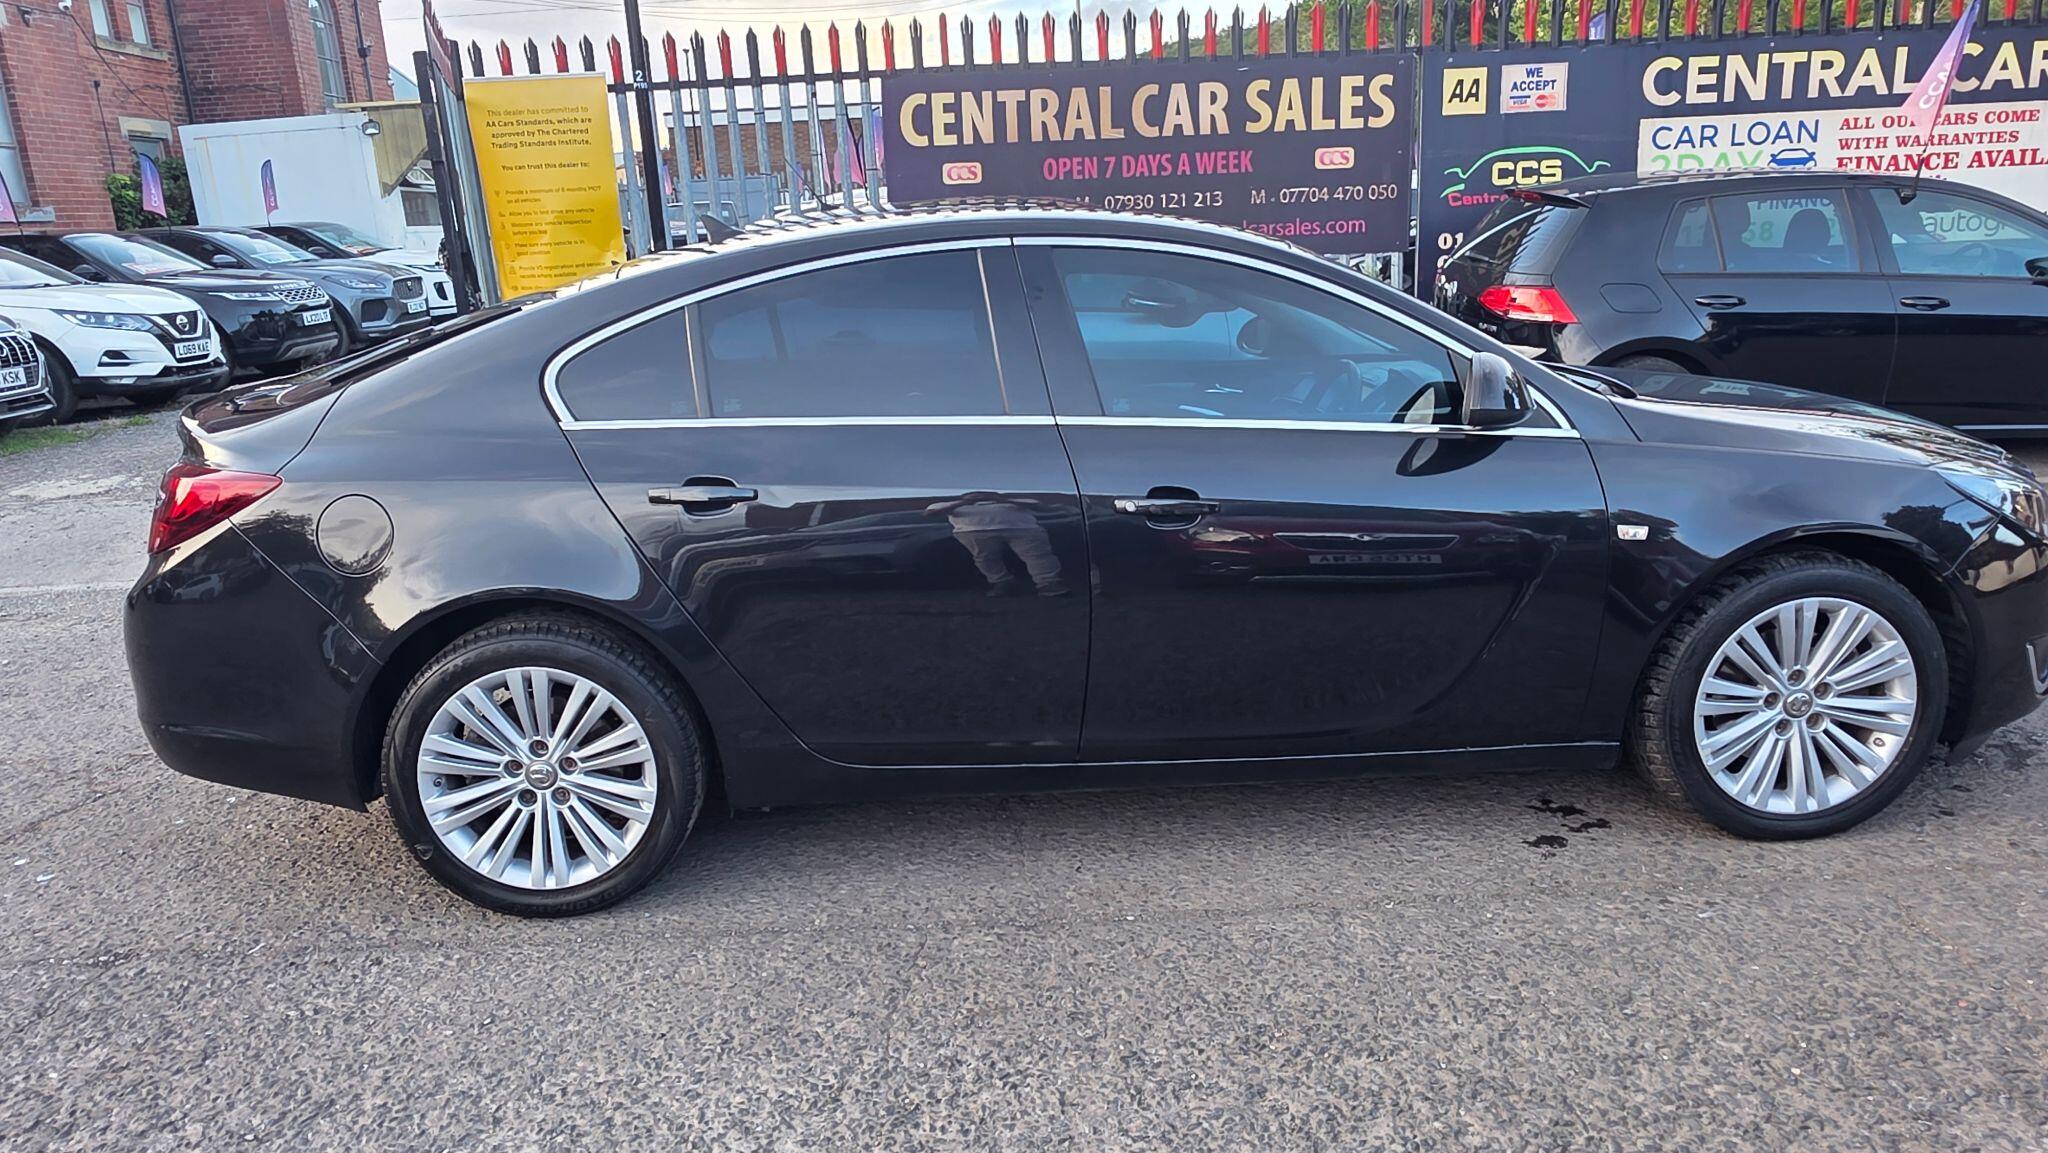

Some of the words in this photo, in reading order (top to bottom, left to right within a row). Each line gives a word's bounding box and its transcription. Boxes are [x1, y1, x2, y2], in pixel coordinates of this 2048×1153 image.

[635, 70, 643, 81] 2
[1525, 67, 1543, 78] WE
[1643, 47, 1918, 106] CENTRAL
[1448, 78, 1480, 103] AA
[1511, 80, 1557, 92] ACCEPT
[900, 86, 1125, 146] CENTRAL
[1131, 82, 1230, 138] CAR
[1245, 74, 1395, 133] SALES
[1839, 117, 1875, 130] ALL
[1984, 109, 2041, 123] COME
[492, 130, 526, 138] approved
[552, 128, 589, 136] Chartered
[1652, 126, 1718, 150] CAR
[1731, 119, 1819, 147] LOAN
[1838, 136, 1889, 150] WITH
[492, 142, 518, 150] Trading
[1044, 157, 1098, 181] OPEN
[1103, 156, 1116, 178] 7
[1122, 154, 1172, 178] DAYS
[1177, 152, 1191, 175] A
[1195, 150, 1253, 174] WEEK
[1836, 151, 1959, 171] FINANCE
[1967, 148, 2048, 168] AVAIL
[1492, 159, 1562, 185] CCS
[1104, 194, 1154, 210] 07930
[1160, 192, 1186, 208] 121
[1194, 190, 1223, 207] 213
[1251, 189, 1265, 204] M
[1280, 187, 1328, 203] 07704
[1334, 186, 1364, 200] 470
[1368, 184, 1398, 200] 050
[2, 373, 22, 386] KSK
